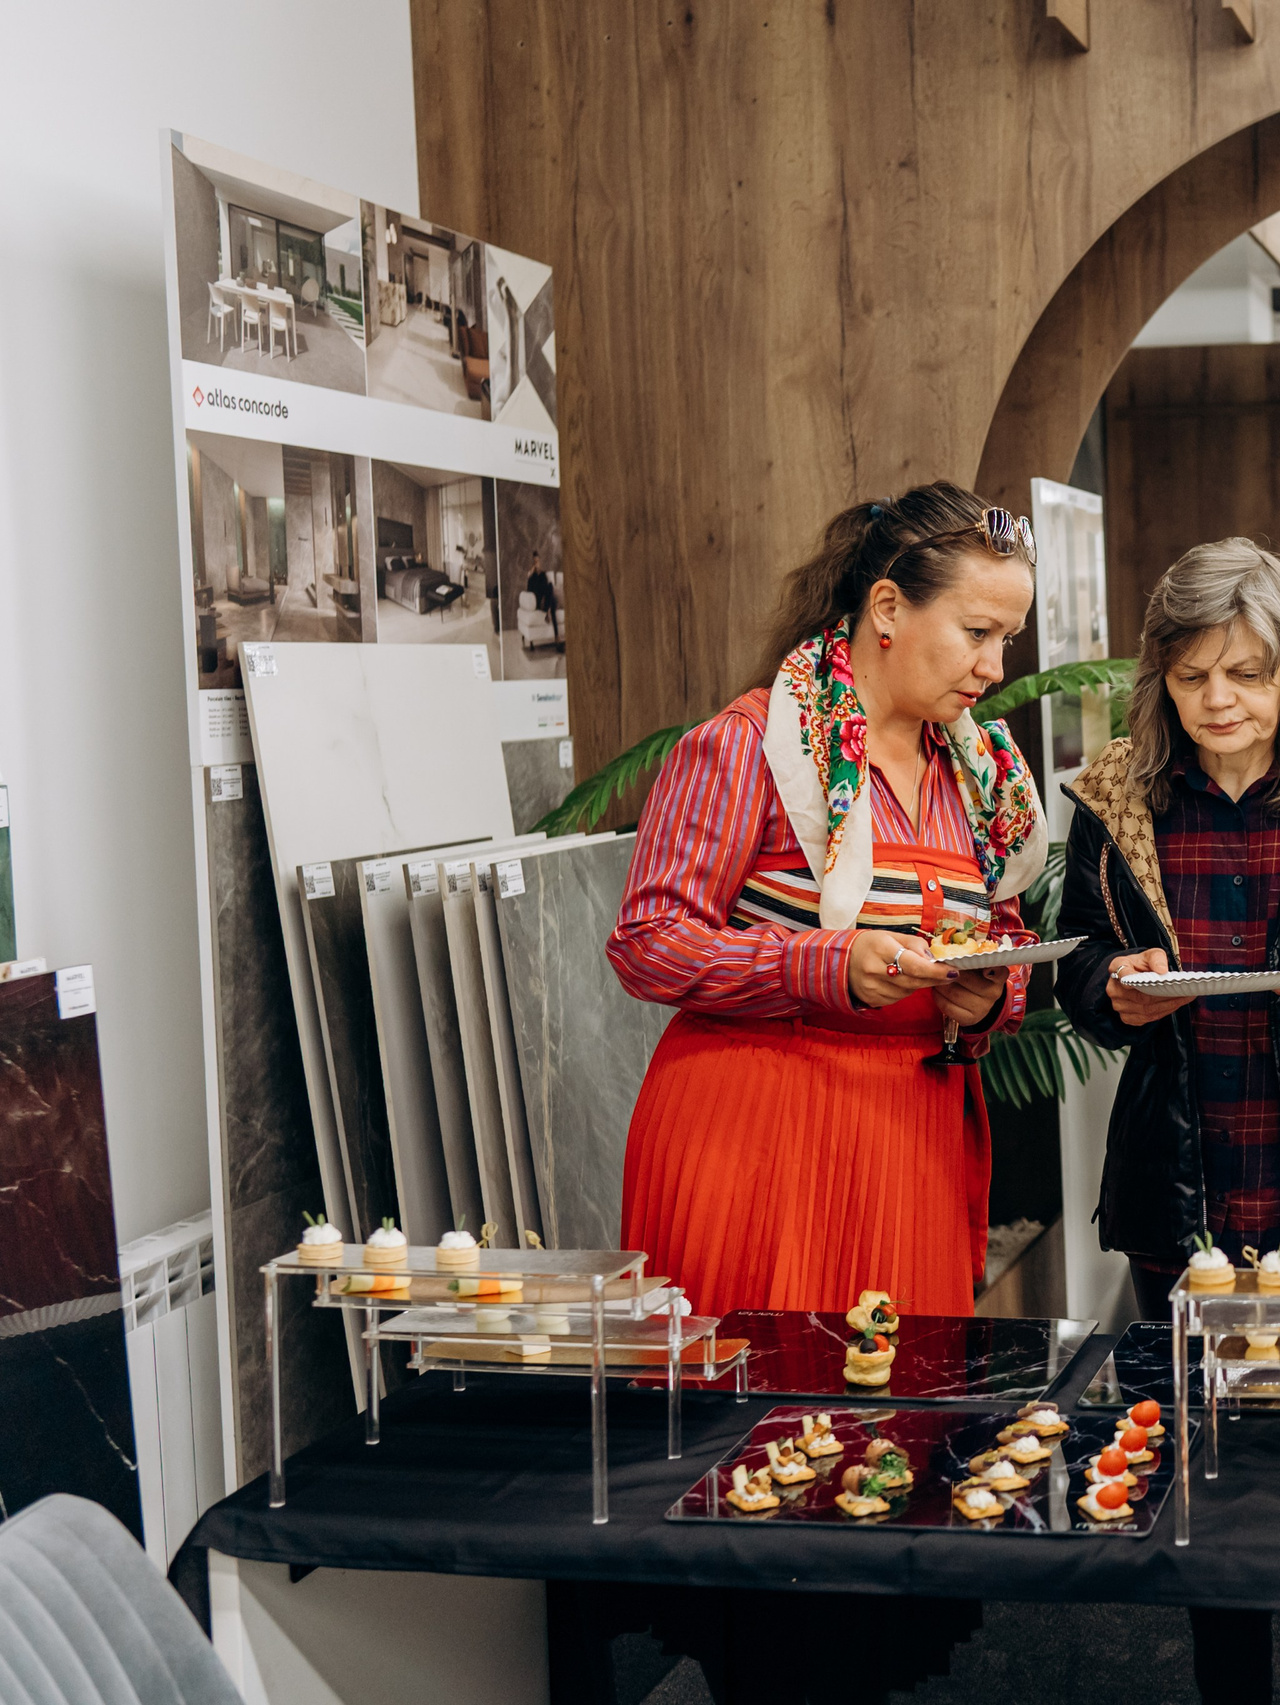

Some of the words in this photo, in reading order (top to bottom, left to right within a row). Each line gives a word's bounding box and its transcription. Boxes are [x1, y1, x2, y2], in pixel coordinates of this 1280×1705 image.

[207, 388, 237, 410] atlas
[238, 398, 289, 419] concorde
[514, 438, 555, 460] MARVEL
[1075, 1522, 1138, 1531] marta
